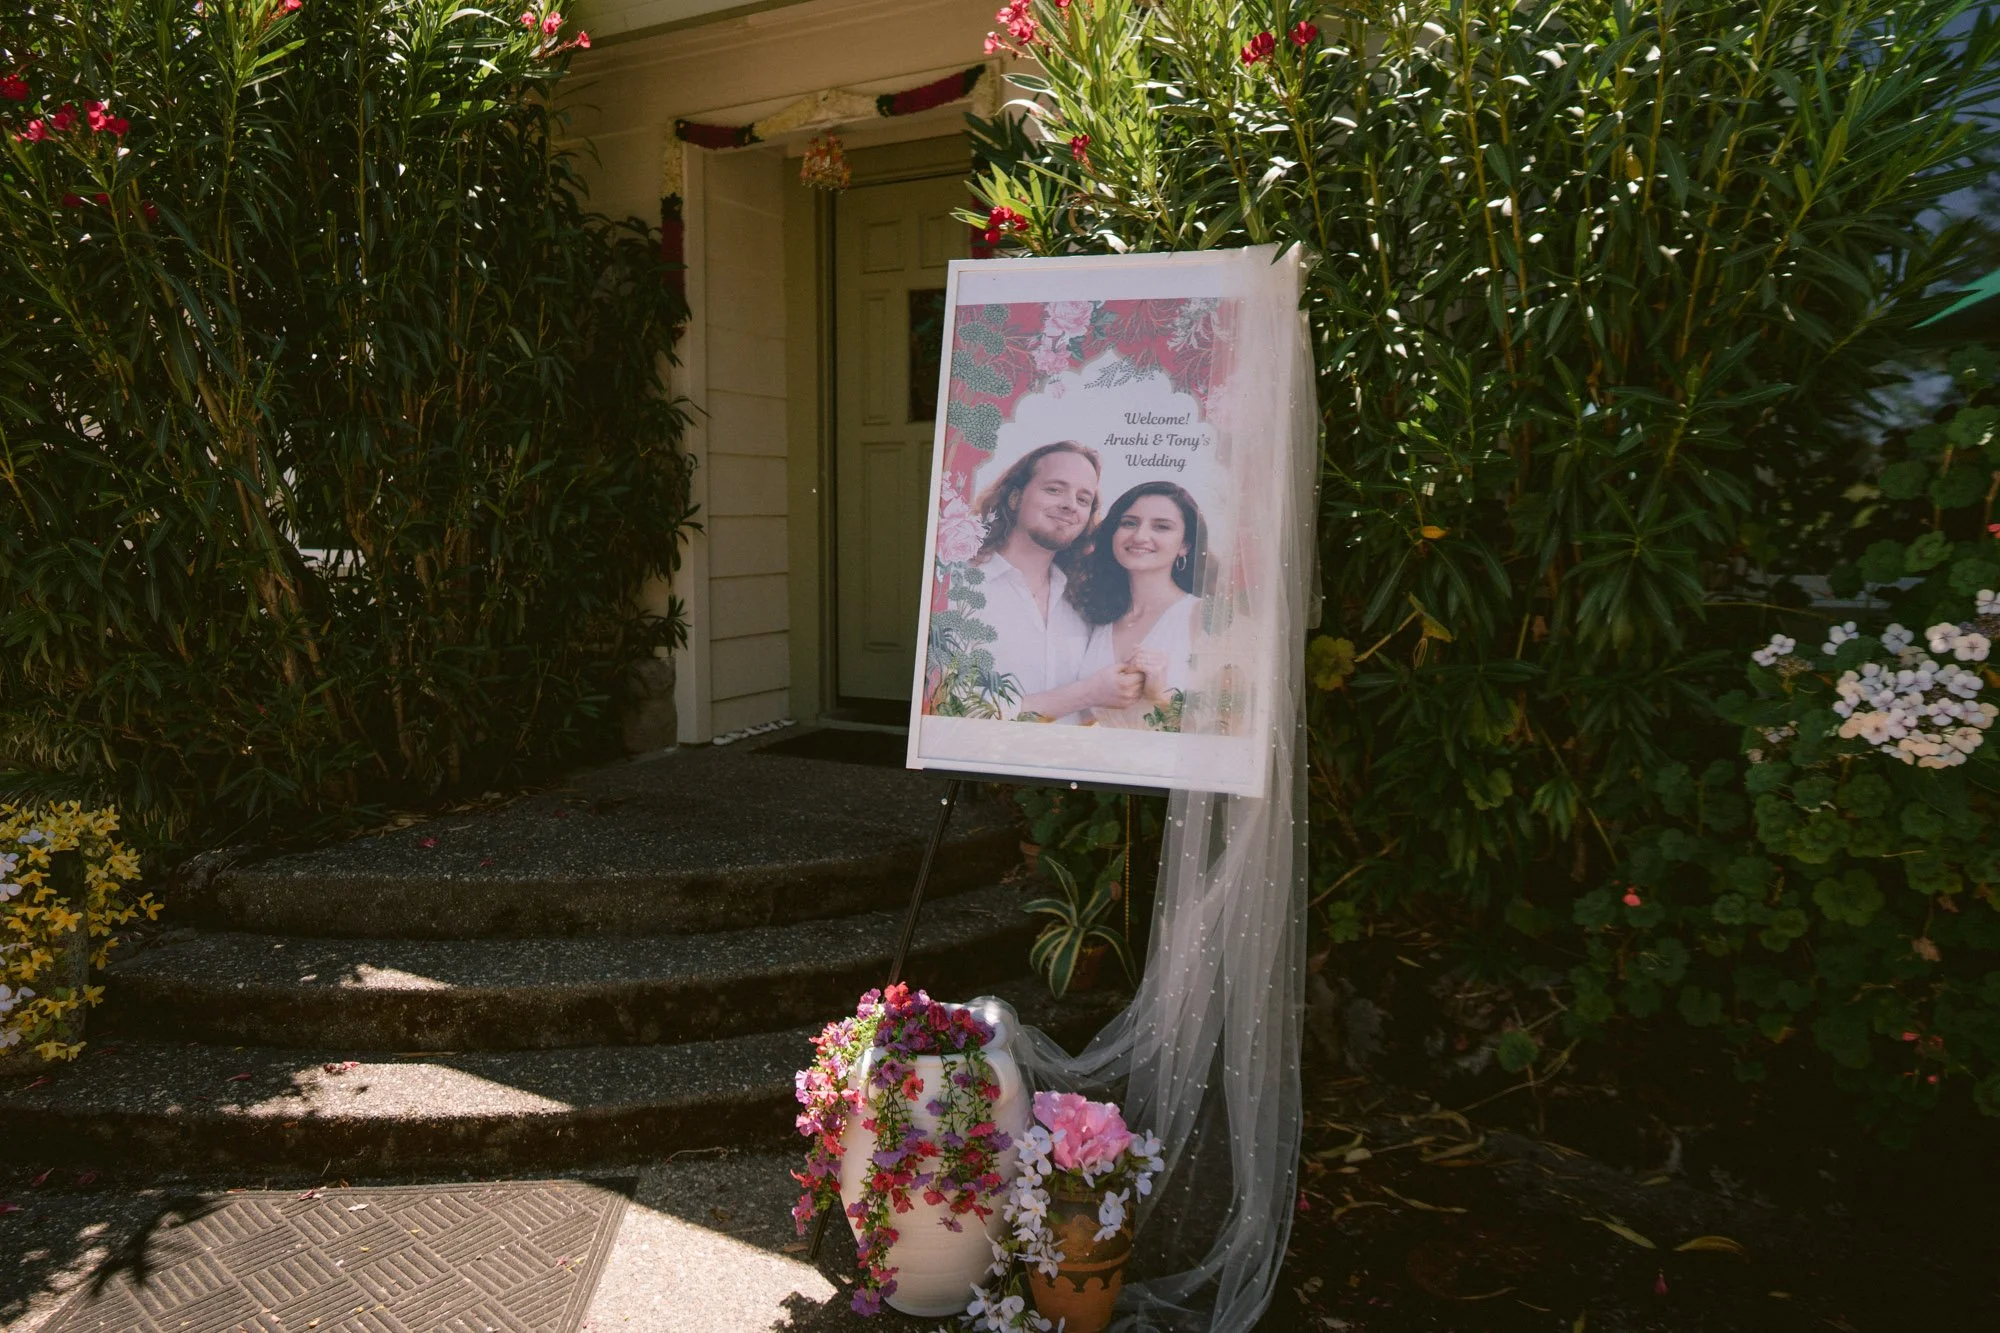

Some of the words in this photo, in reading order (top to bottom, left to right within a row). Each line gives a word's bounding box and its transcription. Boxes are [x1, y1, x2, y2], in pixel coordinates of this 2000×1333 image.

[1124, 411, 1191, 425] Welcome!
[1103, 432, 1149, 446] Arushi
[1152, 433, 1164, 446] &
[1166, 433, 1211, 452] Tony's
[1125, 453, 1187, 473] Wedding
